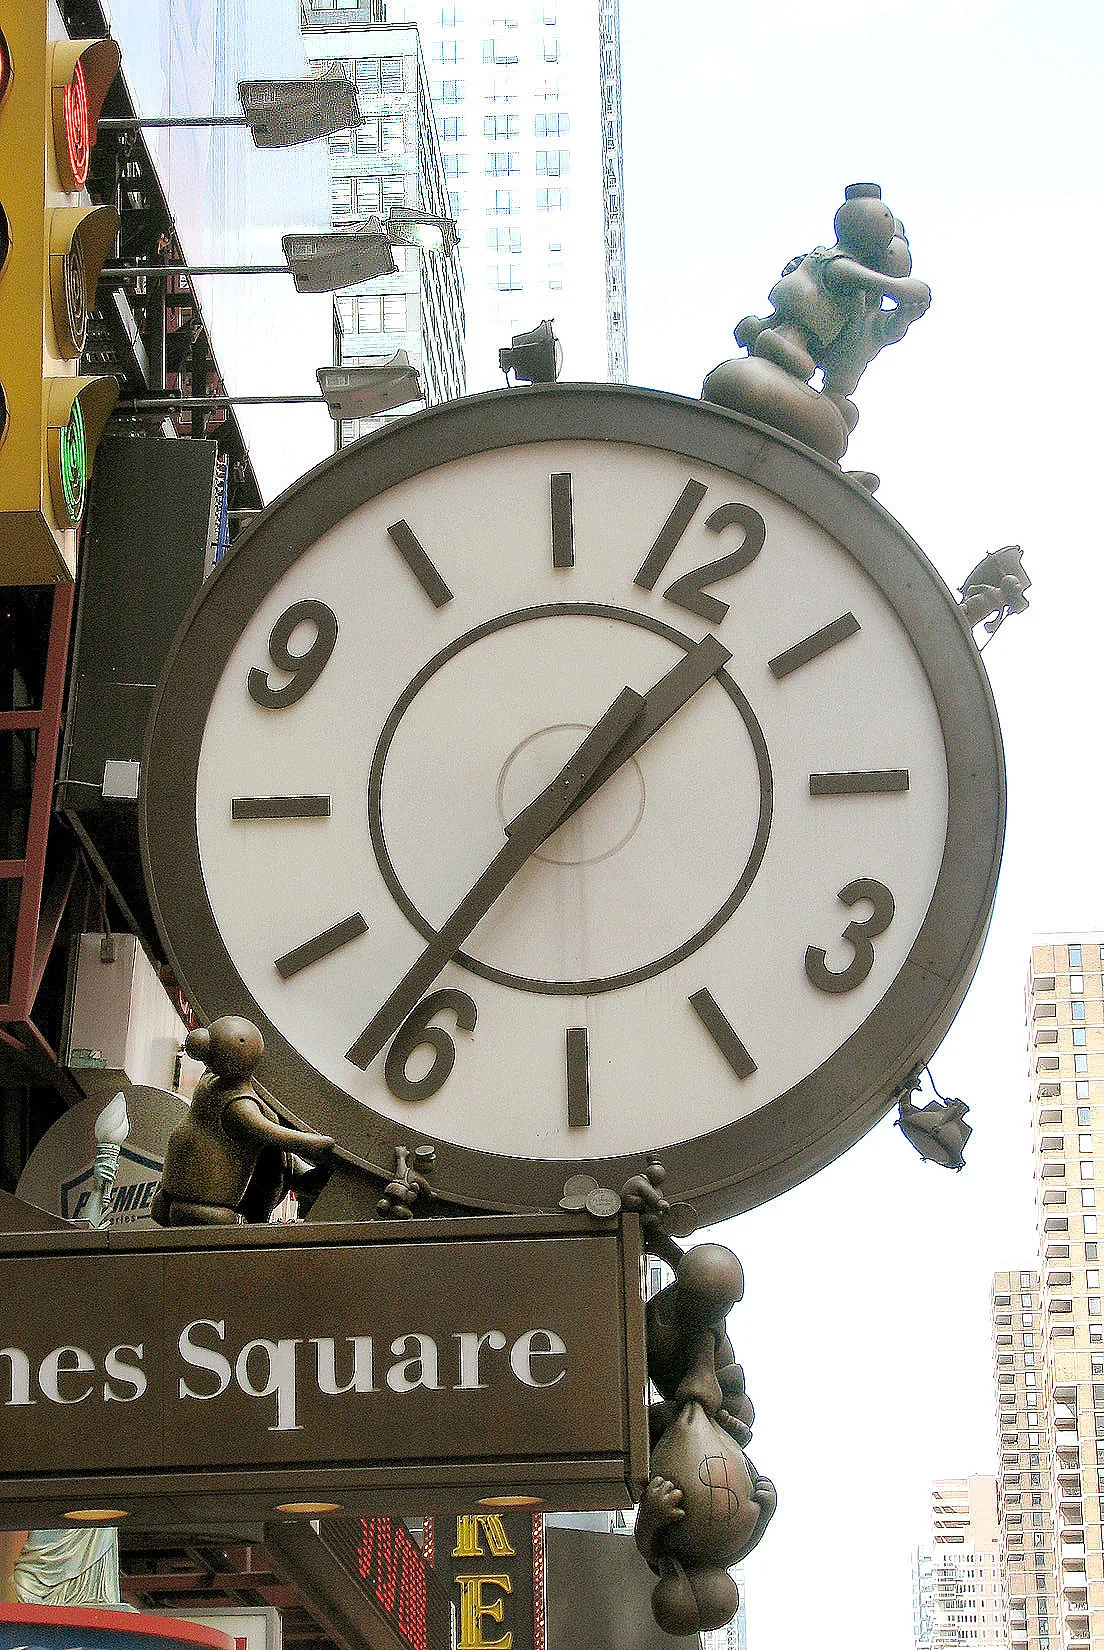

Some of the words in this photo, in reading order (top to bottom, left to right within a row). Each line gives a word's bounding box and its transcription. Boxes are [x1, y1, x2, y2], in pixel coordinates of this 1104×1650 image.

[633, 478, 766, 625] 12
[247, 599, 338, 709] 9
[804, 877, 895, 993] 3
[385, 988, 478, 1101] 6
[178, 1318, 567, 1431] Square
